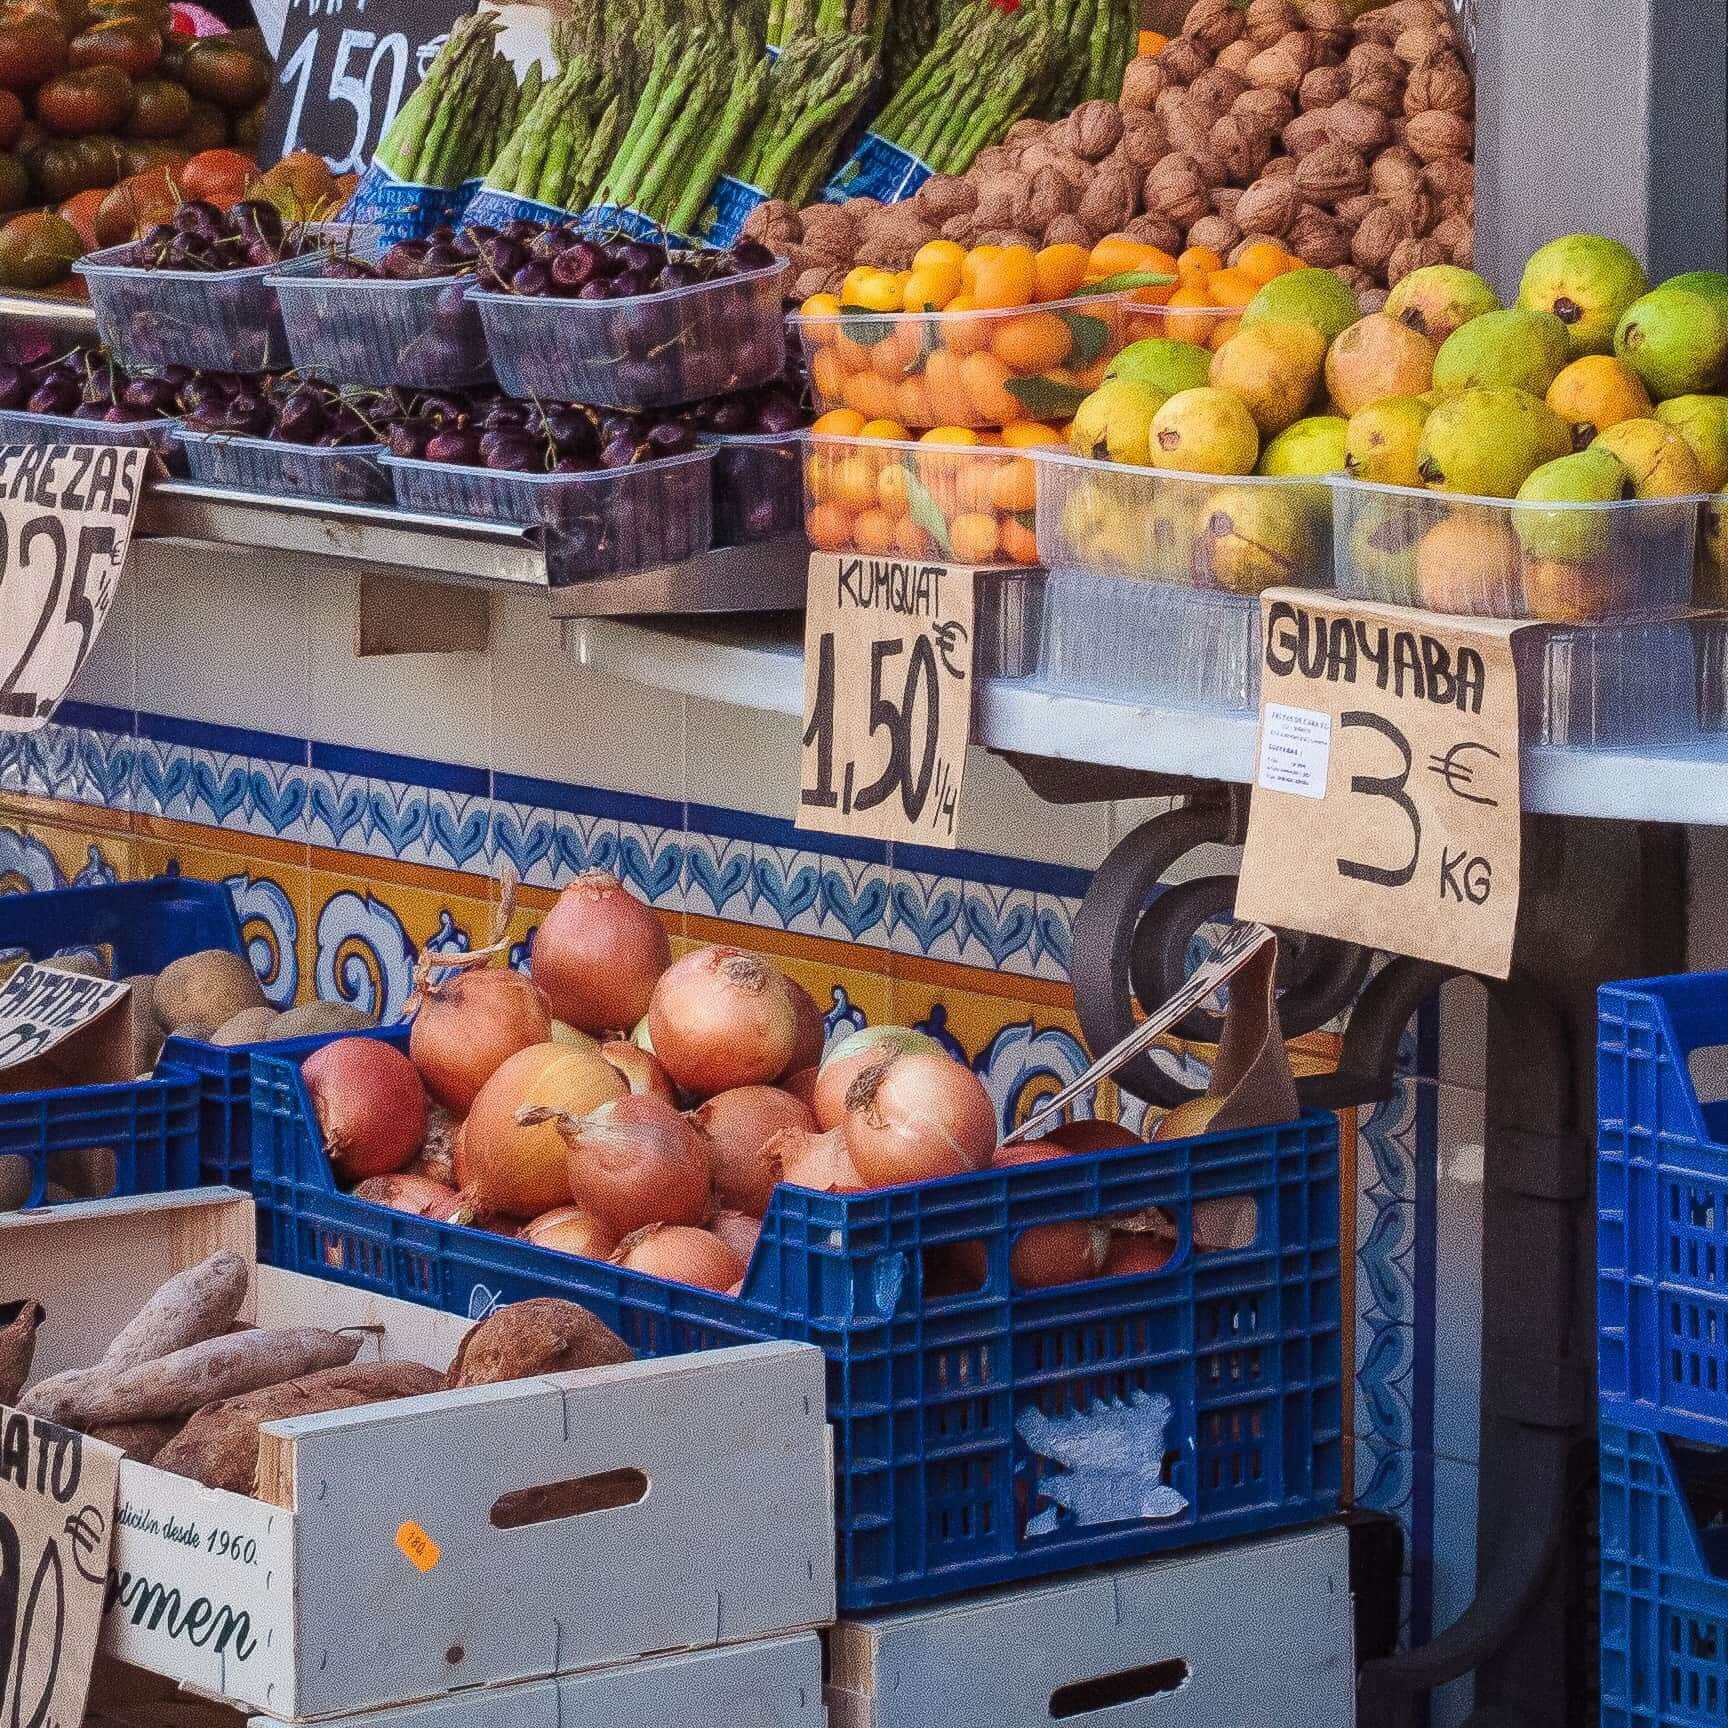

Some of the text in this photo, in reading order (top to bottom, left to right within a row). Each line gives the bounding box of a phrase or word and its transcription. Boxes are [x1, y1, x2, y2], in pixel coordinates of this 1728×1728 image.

[838, 557, 948, 618] KUMQUAT
[1265, 600, 1486, 716] GUAYABA
[801, 620, 969, 825] 1,50 €
[1336, 710, 1422, 888] 3
[1427, 741, 1501, 807] €
[1439, 845, 1494, 906] KG
[63, 1504, 105, 1585] €
[163, 1515, 201, 1549] desde
[207, 1527, 258, 1566] 1960.
